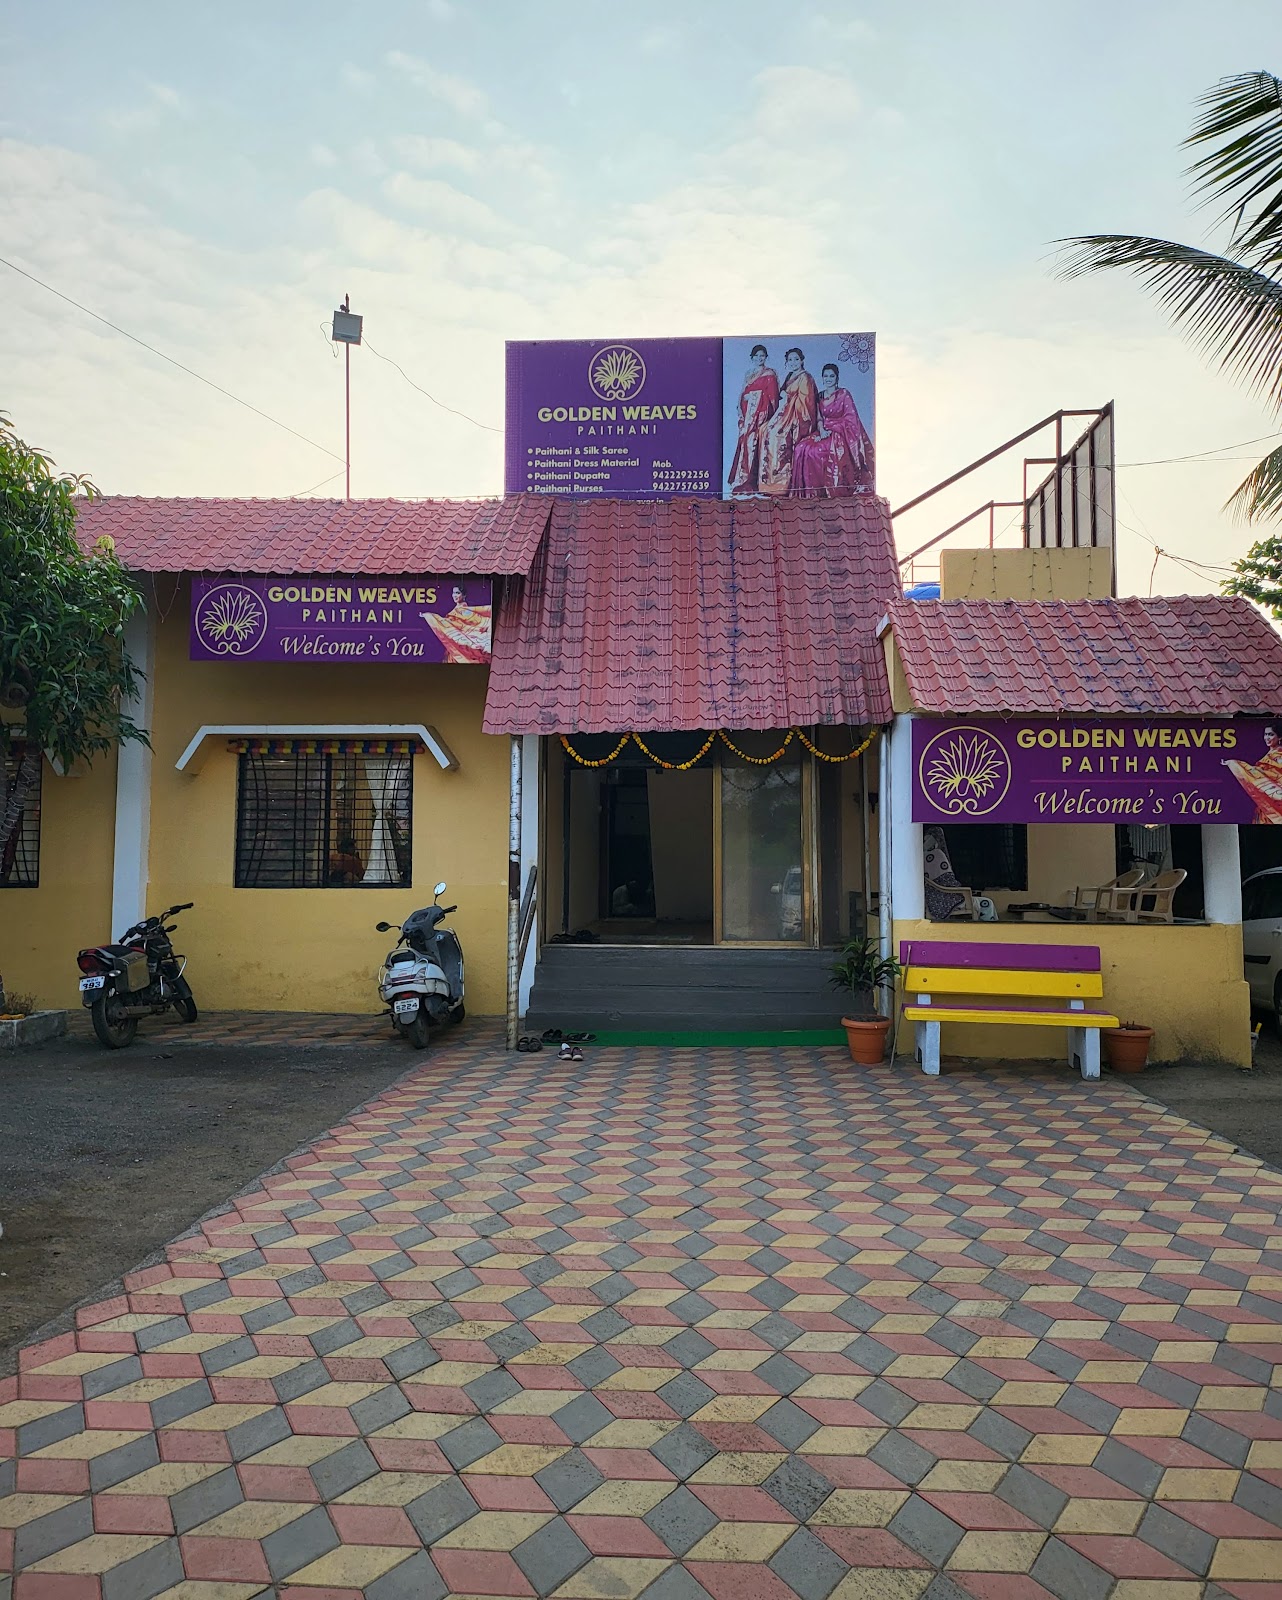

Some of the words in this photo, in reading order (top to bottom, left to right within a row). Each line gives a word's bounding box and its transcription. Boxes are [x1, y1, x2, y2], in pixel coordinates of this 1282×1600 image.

[537, 406, 616, 422] GOLDEN
[622, 405, 697, 420] WEAVES
[577, 424, 657, 436] PAITHANI
[535, 447, 572, 455] Paithani
[583, 446, 600, 455] Silk
[602, 446, 629, 455] Saree
[534, 459, 571, 468] Paithani
[573, 459, 599, 468] Dress
[600, 458, 640, 467] Material
[652, 460, 674, 468] Mob.
[534, 472, 571, 481] Paithani
[573, 472, 611, 482] Dupatta
[652, 470, 710, 479] 9422292256
[534, 484, 571, 493] Paithani
[573, 484, 603, 493] Purses
[652, 482, 710, 491] 9422757639
[267, 586, 352, 603] GOLDEN
[357, 587, 437, 604] WEAVES
[302, 608, 403, 623] PAITHANI
[279, 634, 381, 656] Welcome's
[386, 637, 425, 657] You
[1016, 728, 1125, 748] GOLDEN
[1133, 728, 1237, 749] WEAVES
[1061, 756, 1192, 773] PAITHANI
[1033, 788, 1165, 816] Welcome's
[1171, 790, 1223, 816] You
